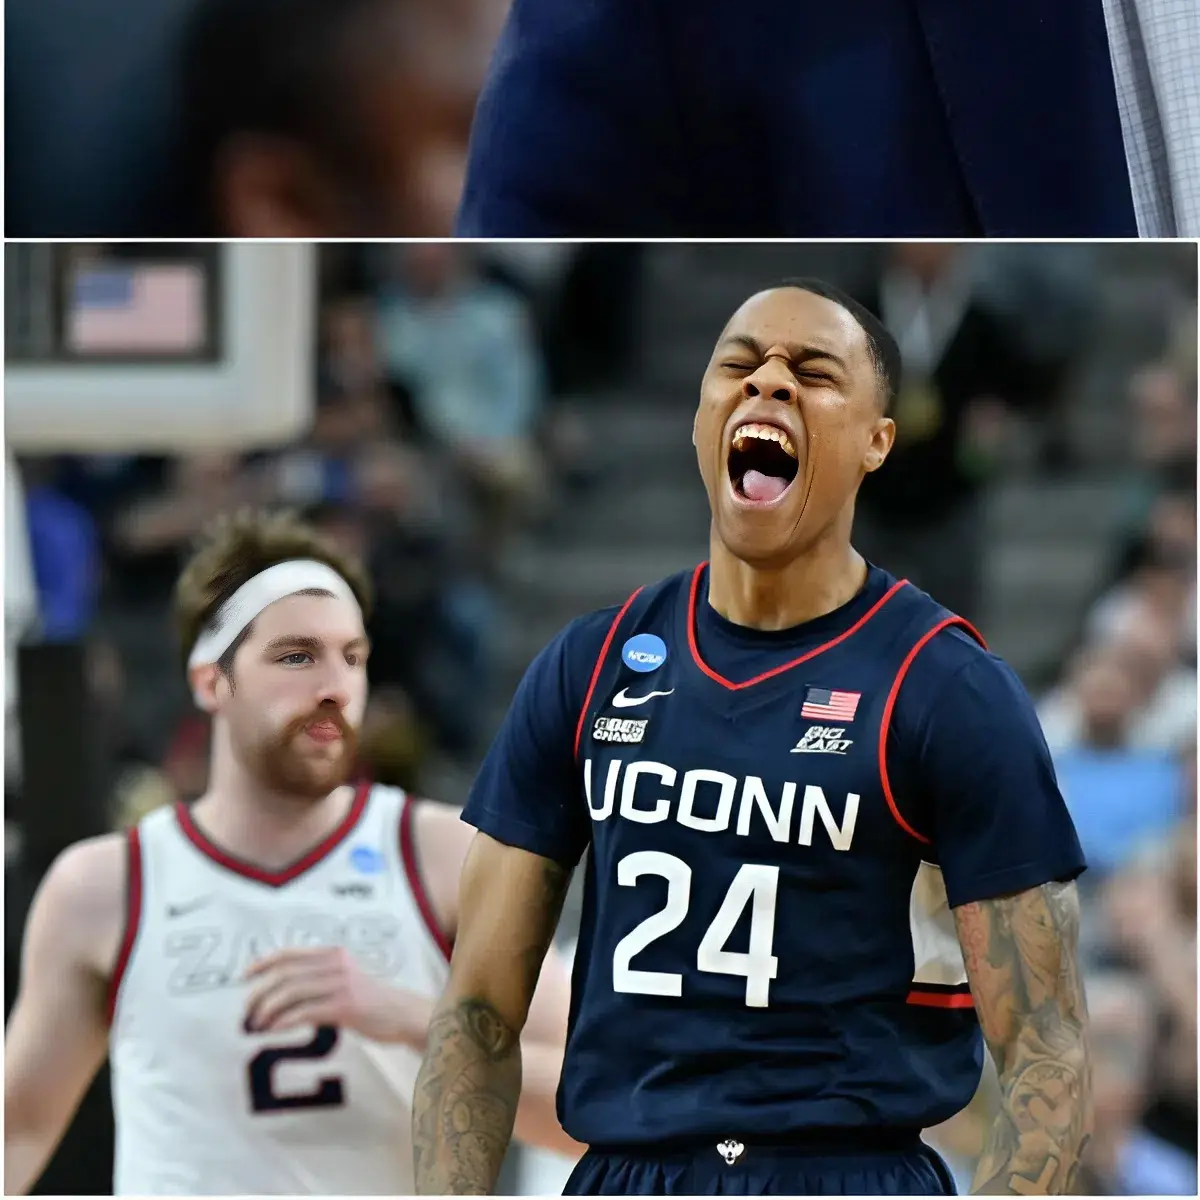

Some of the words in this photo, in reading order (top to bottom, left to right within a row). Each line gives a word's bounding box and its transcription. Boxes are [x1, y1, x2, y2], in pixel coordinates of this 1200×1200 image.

[584, 759, 860, 851] UCONN
[612, 850, 779, 1008] 24
[243, 1012, 345, 1114] 2
